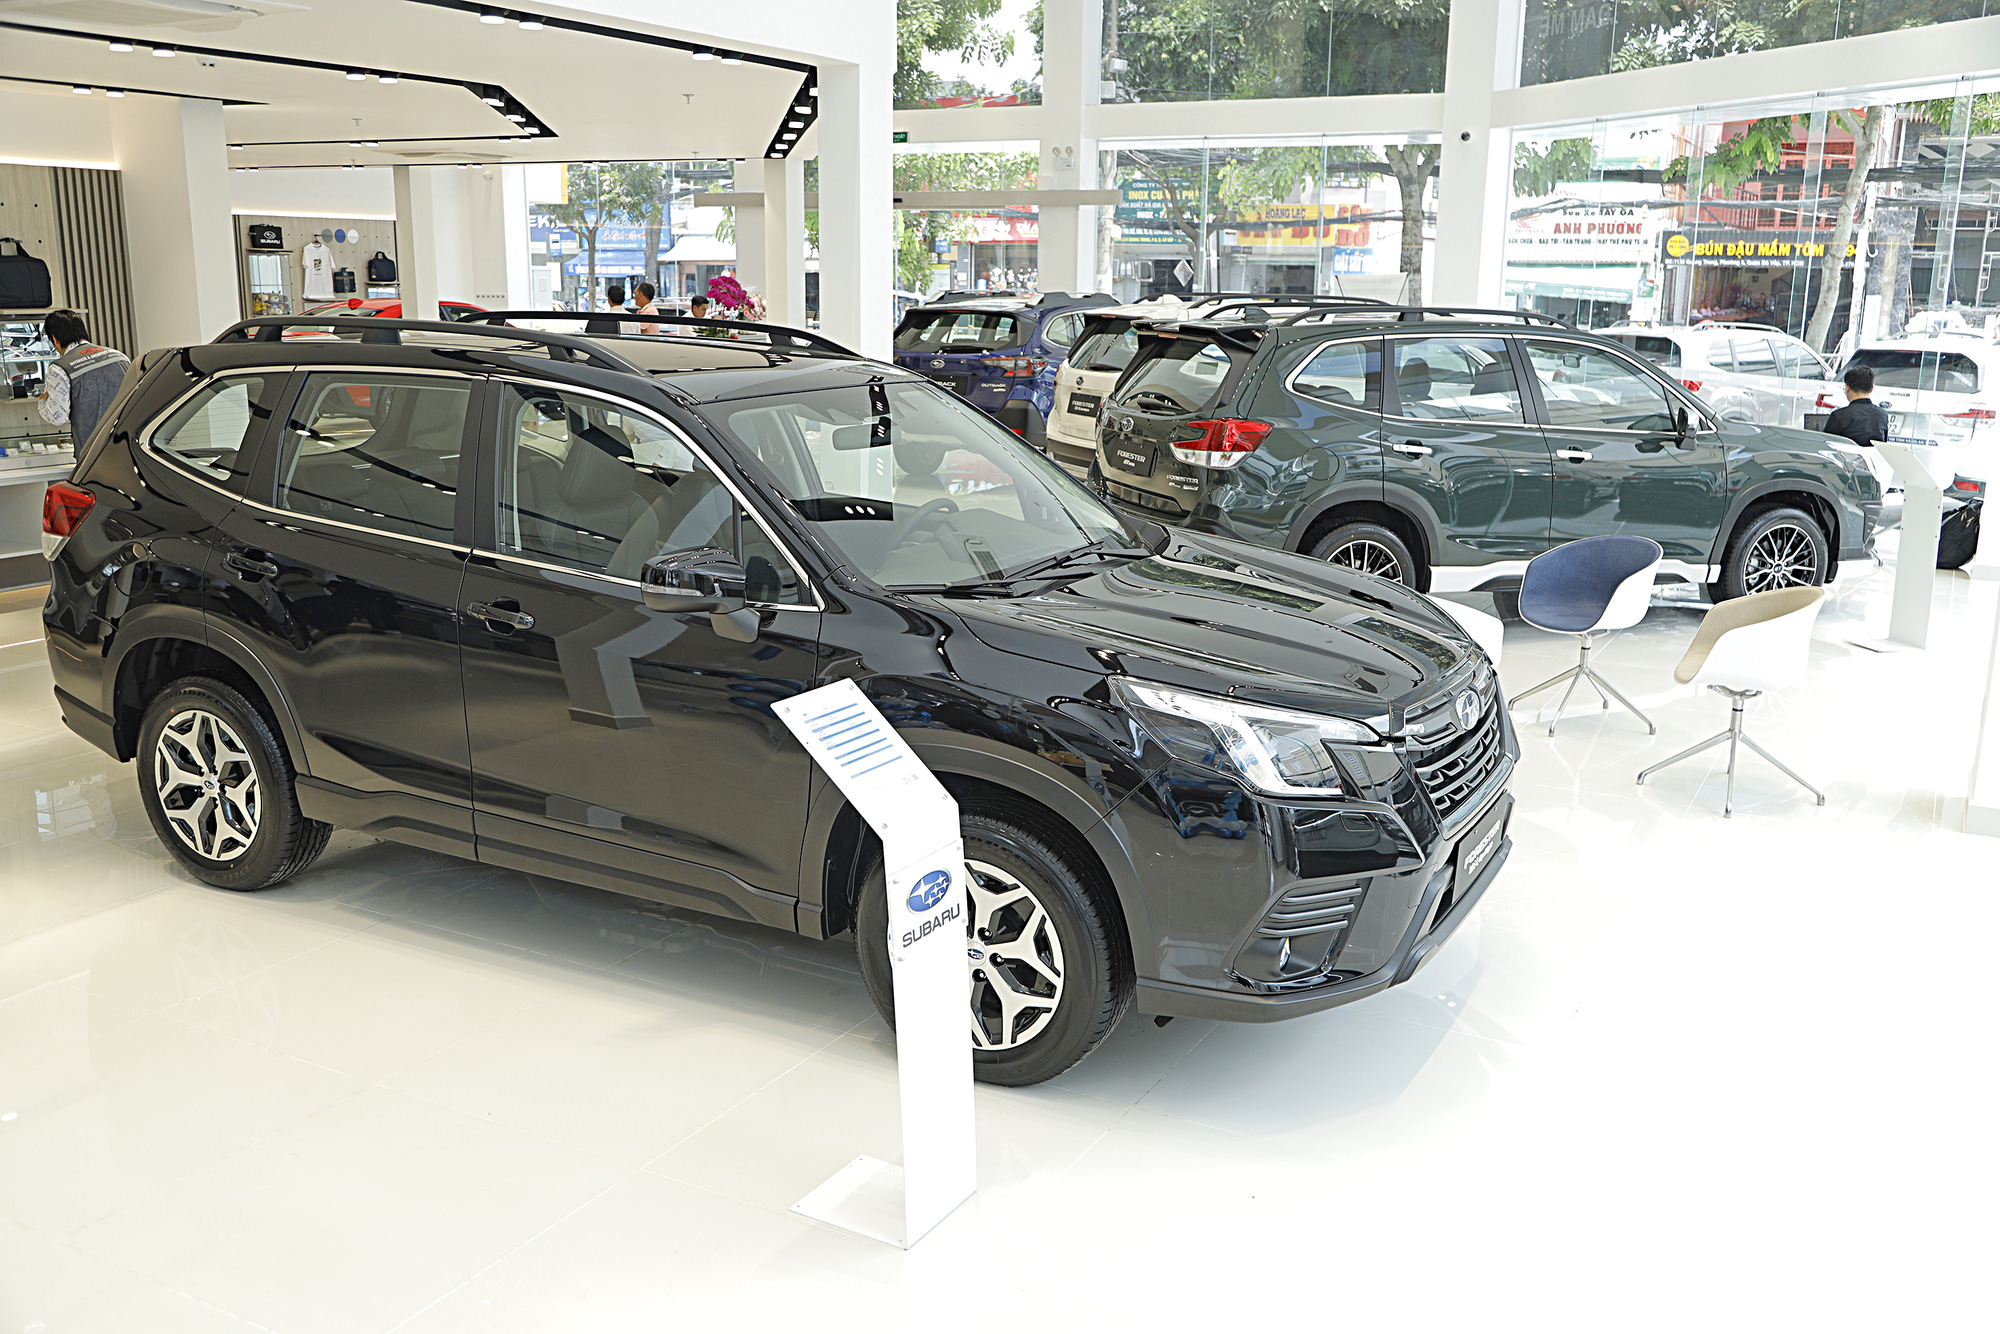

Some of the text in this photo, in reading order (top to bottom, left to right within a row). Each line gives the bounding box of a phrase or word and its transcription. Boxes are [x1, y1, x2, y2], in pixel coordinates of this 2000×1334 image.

[1128, 190, 1149, 200] INOX
[1553, 222, 1582, 234] ANH
[1696, 239, 1724, 256] BÚN
[1726, 239, 1754, 259] ĐẬU
[1757, 238, 1791, 256] MẮM
[1794, 240, 1825, 257] TÔM
[1072, 400, 1095, 408] FORESTER
[1117, 449, 1146, 462] FORESTER
[1166, 474, 1199, 484] FORESTER
[1464, 819, 1500, 870] FORESTER
[902, 903, 961, 948] SUBARU
